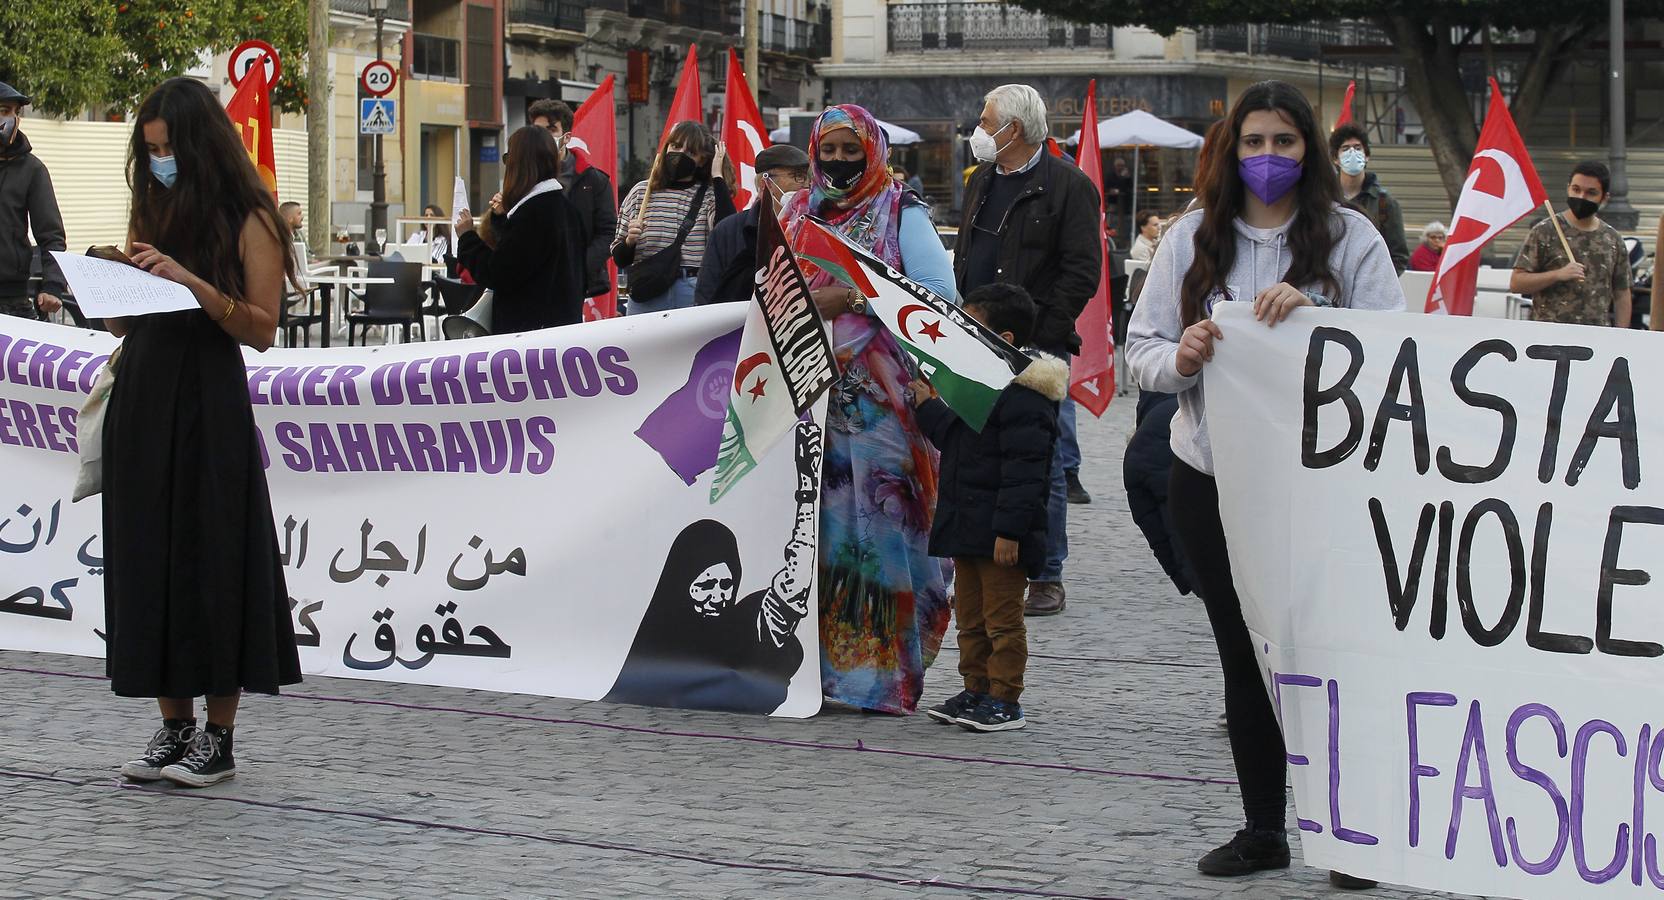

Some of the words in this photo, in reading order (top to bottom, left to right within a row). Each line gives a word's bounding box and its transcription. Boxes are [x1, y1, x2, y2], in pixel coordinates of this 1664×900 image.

[369, 72, 389, 84] 20
[754, 245, 813, 352] SAHARA
[246, 365, 366, 405] ENER
[371, 346, 639, 405] DERECHOS
[782, 328, 833, 407] LIBRE
[1302, 326, 1641, 490] BASTA
[275, 415, 557, 475] SAHARAUIS
[447, 534, 527, 591] من
[1368, 498, 1664, 656] VIOLE
[342, 600, 512, 671] حقوق
